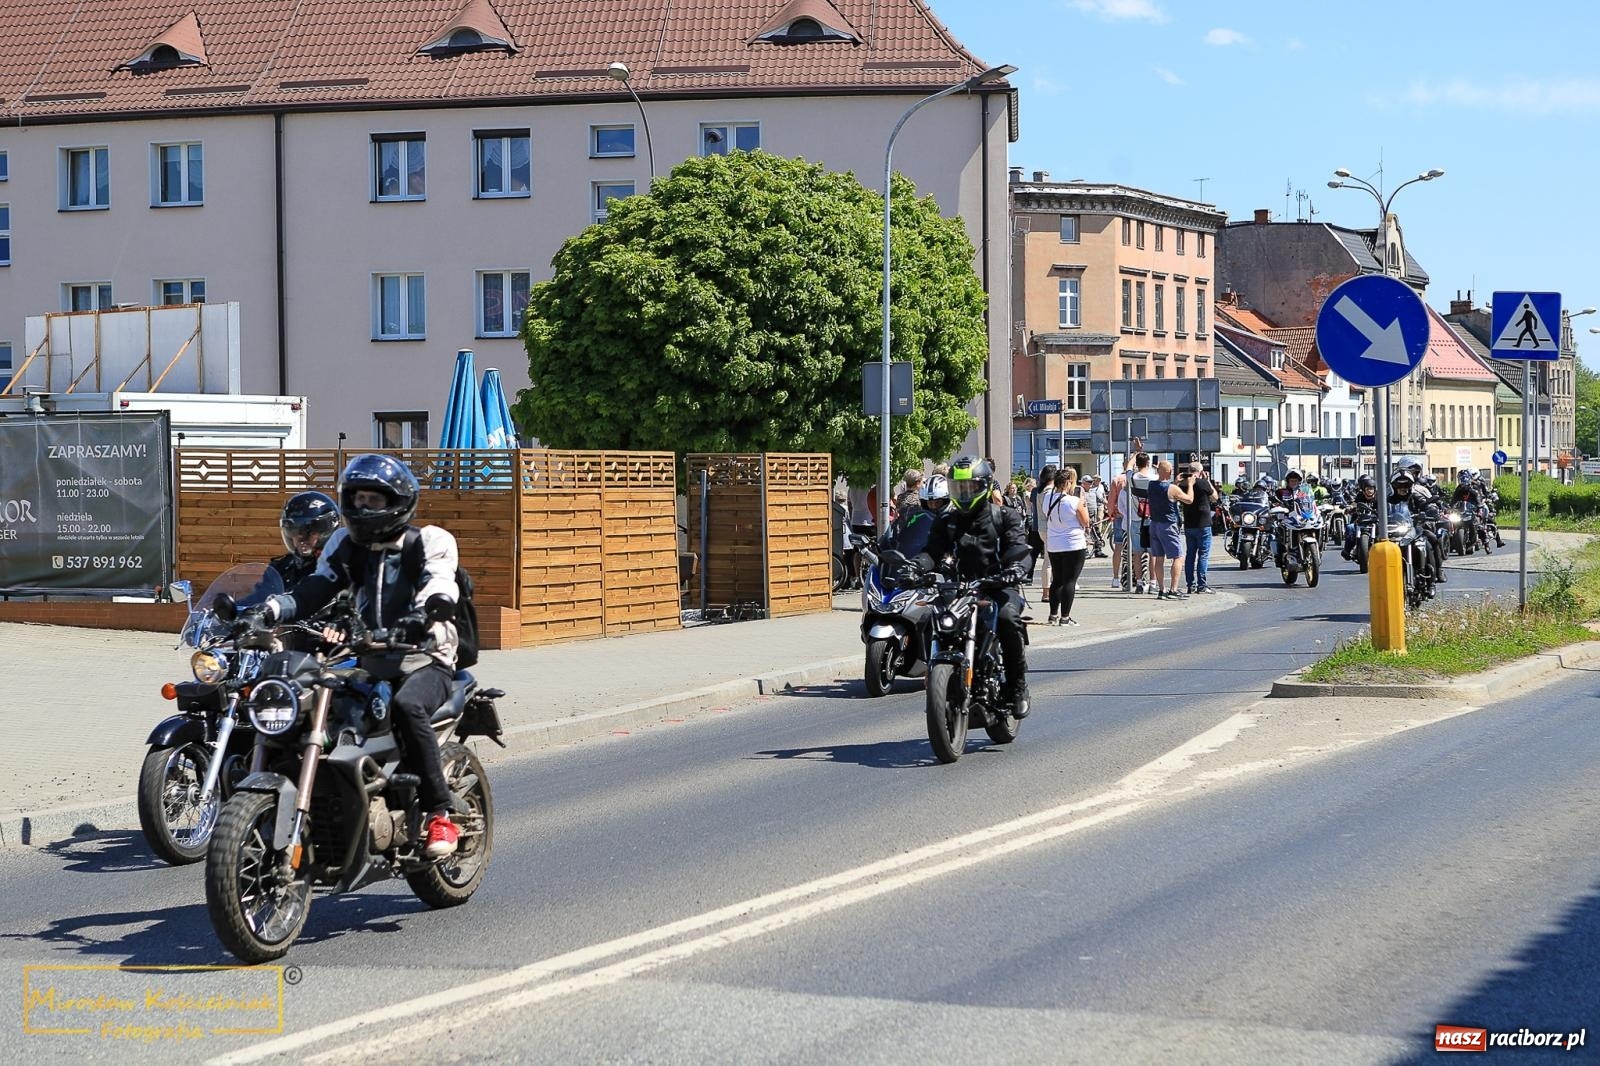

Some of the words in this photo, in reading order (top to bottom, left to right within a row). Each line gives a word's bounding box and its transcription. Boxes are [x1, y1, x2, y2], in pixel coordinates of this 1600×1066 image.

[47, 444, 147, 459] ZAPRASZAMY!
[56, 476, 107, 487] poniedziałek
[114, 476, 143, 486] sobota
[56, 489, 79, 498] 11.00
[86, 489, 109, 498] 23.00
[57, 512, 93, 521] niedziela
[57, 524, 80, 533] 15.00
[87, 524, 111, 533] 22.00
[66, 556, 90, 569] 537
[93, 556, 115, 569] 891
[119, 556, 143, 569] 962
